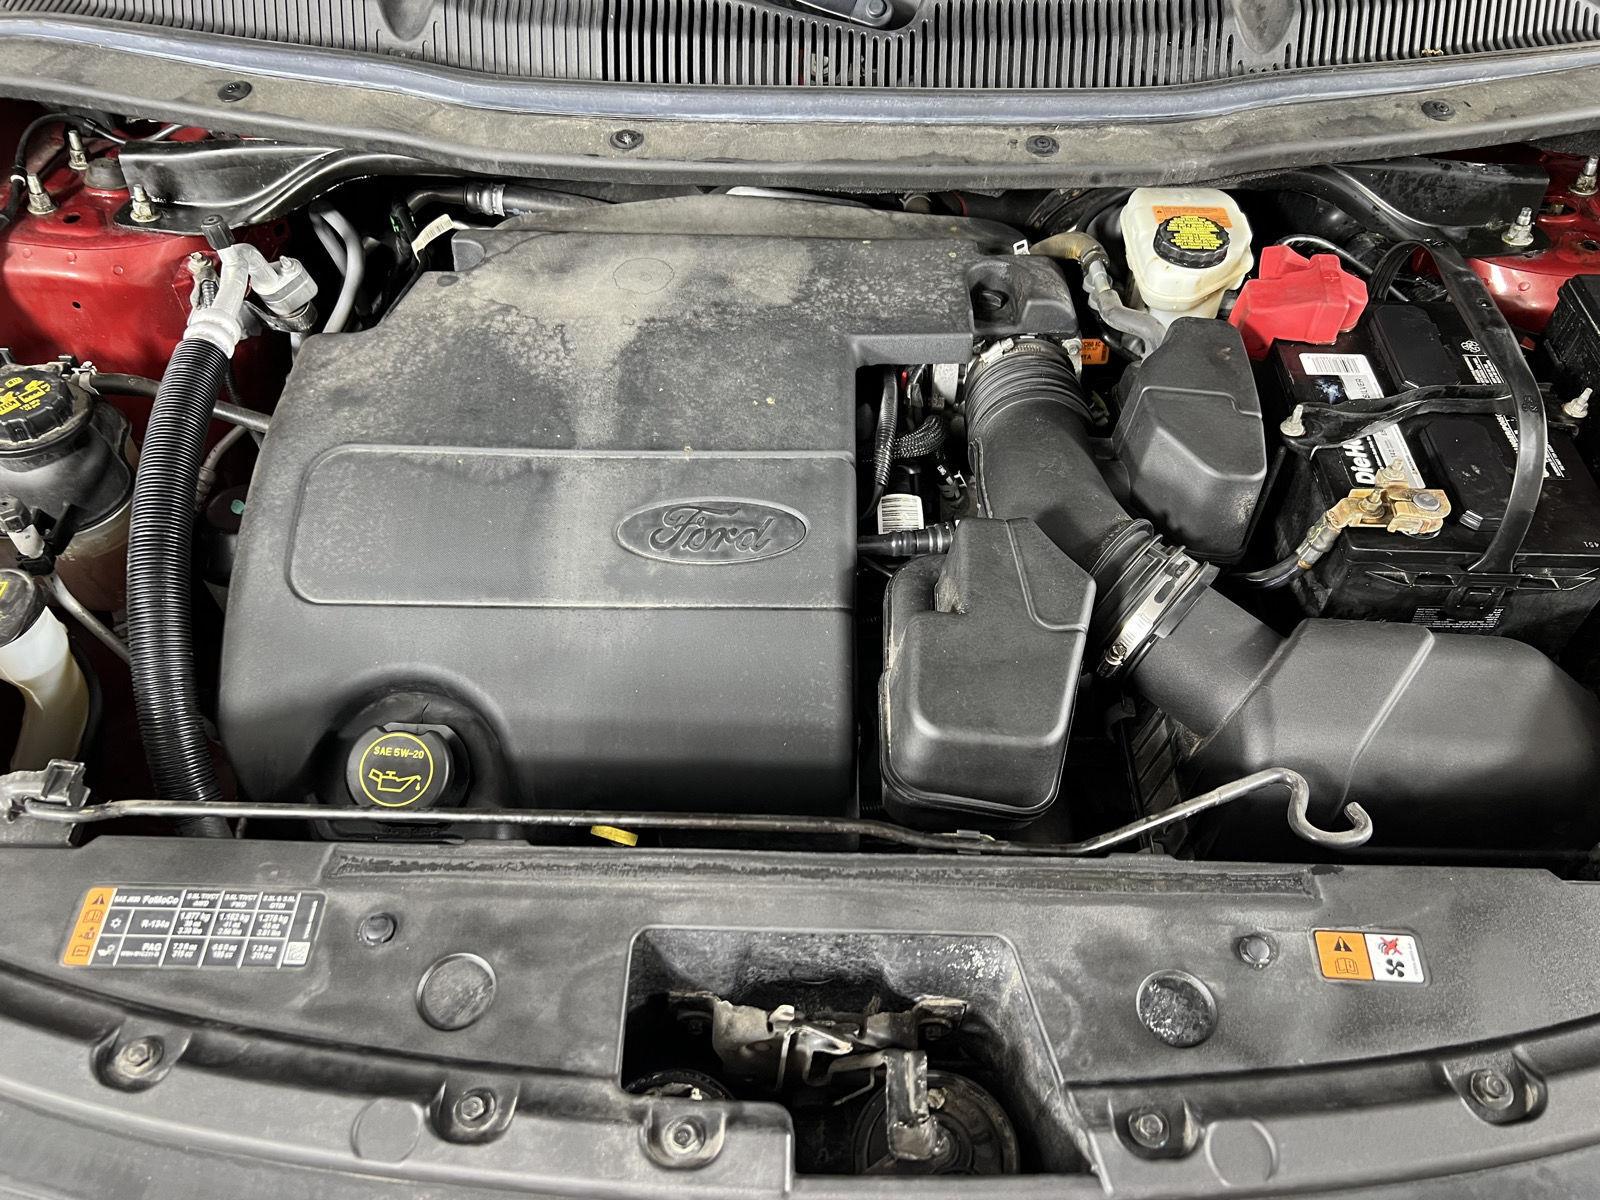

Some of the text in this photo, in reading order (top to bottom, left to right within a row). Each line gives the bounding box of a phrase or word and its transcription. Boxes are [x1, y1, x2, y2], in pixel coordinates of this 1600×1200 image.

[648, 505, 775, 552] Ford
[373, 746, 425, 759] SAE 5W-20
[142, 894, 179, 905] FoMoCo
[200, 911, 211, 923] kg
[239, 913, 250, 924] kg
[279, 914, 289, 925] kg
[142, 942, 162, 951] PAG
